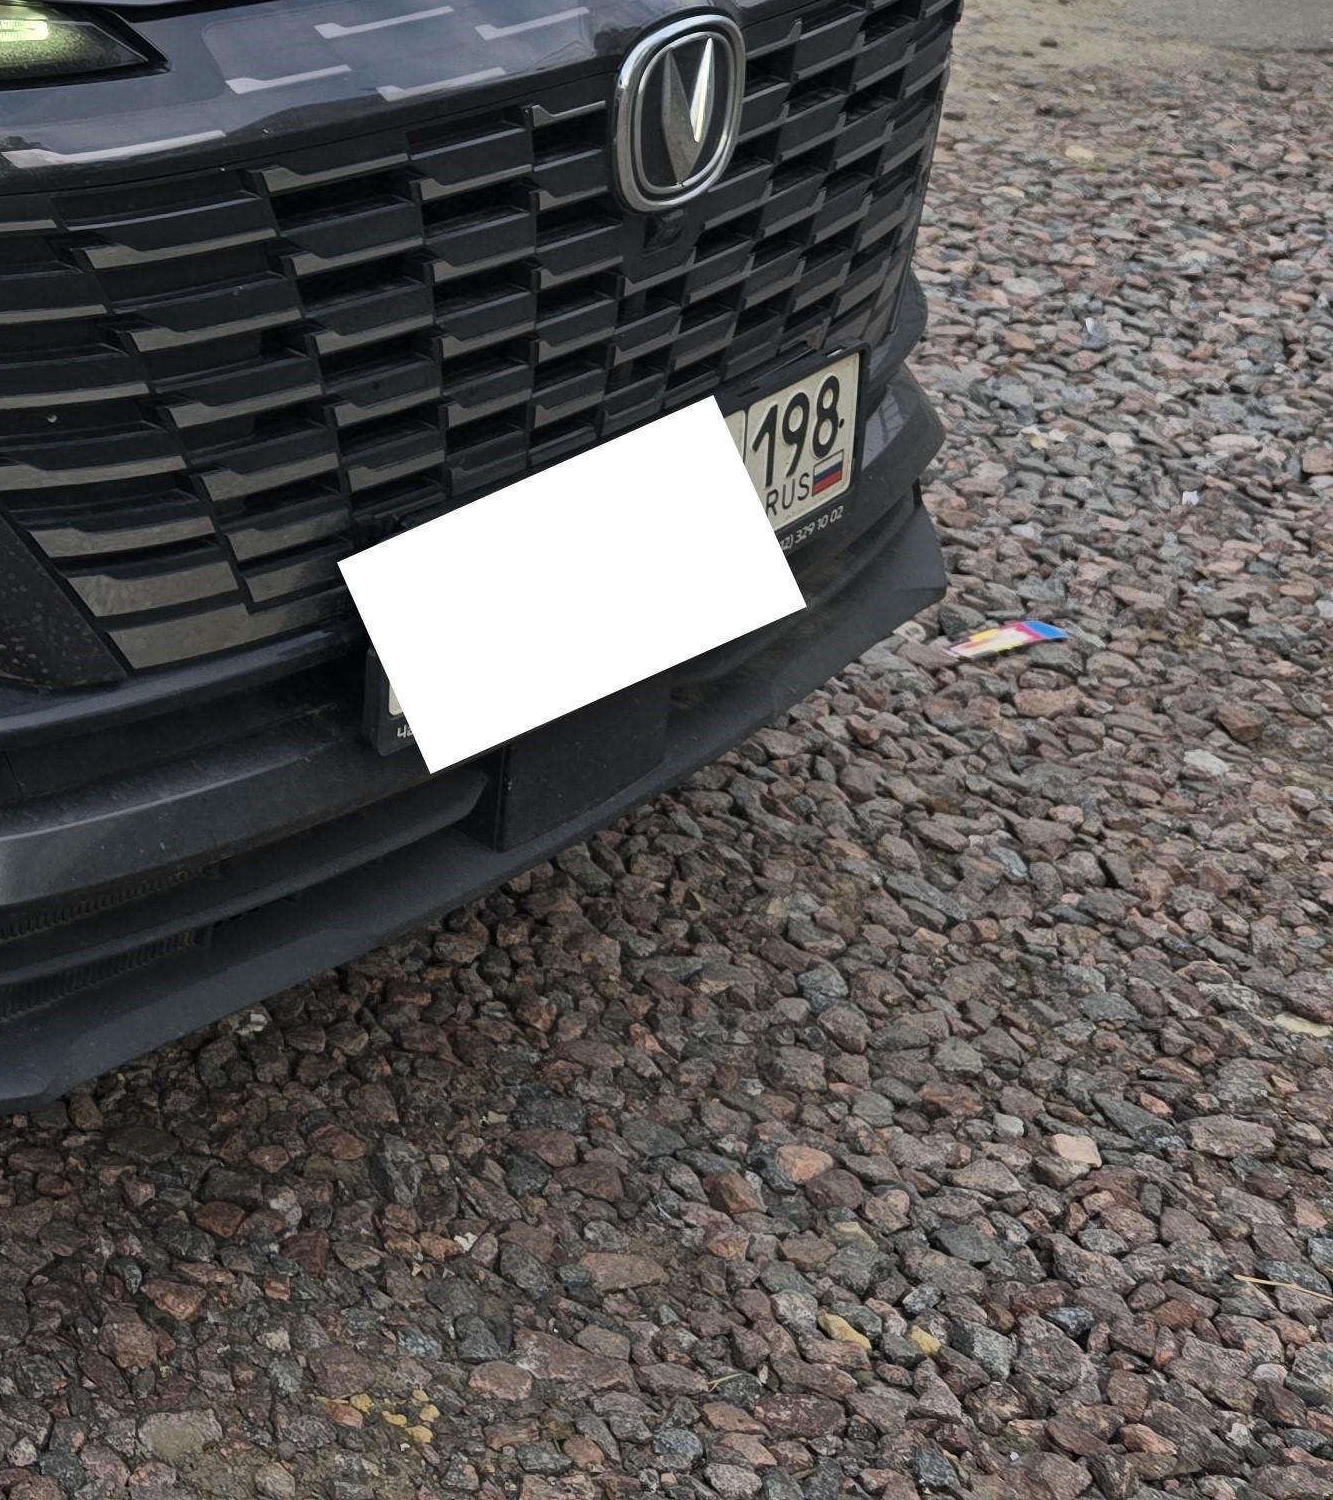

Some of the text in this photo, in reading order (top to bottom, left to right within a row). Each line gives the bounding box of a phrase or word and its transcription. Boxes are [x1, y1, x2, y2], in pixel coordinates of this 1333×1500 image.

[752, 374, 840, 488] 198
[766, 472, 811, 517] RUS
[795, 521, 816, 544] 329
[817, 514, 829, 531] 10
[830, 505, 844, 523] 02
